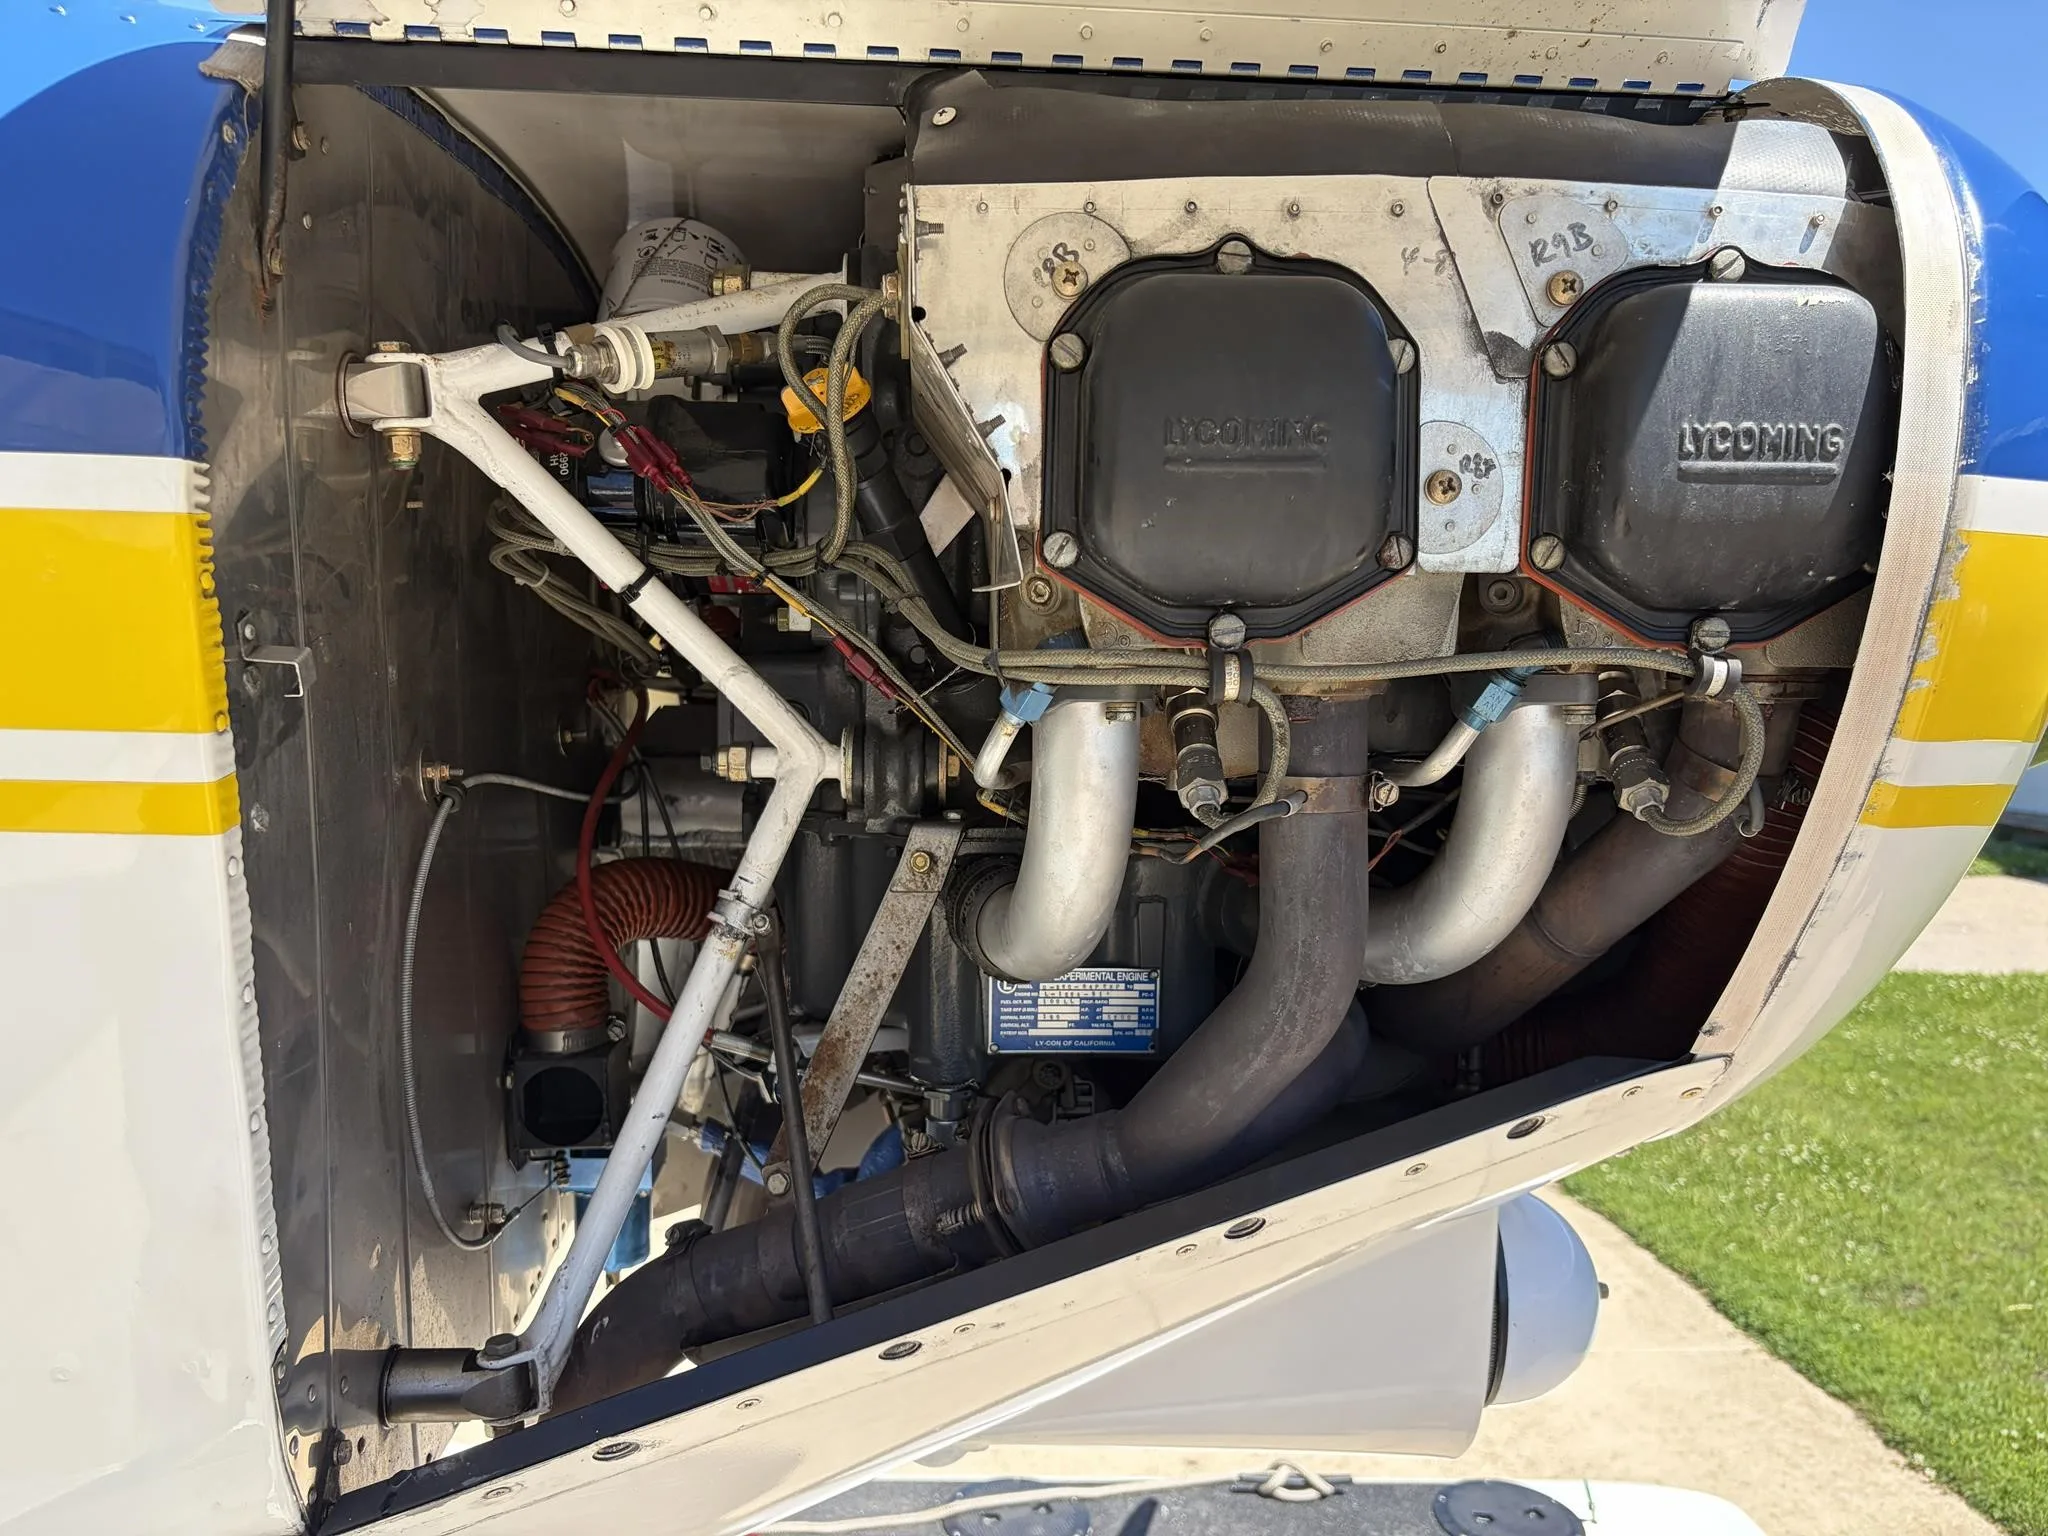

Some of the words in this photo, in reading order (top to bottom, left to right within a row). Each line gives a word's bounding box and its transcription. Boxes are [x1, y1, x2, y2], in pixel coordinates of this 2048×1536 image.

[1164, 414, 1330, 450] LYCOMING
[1678, 420, 1845, 462] LYCOMING
[1054, 971, 1116, 982] PERIMENTAL
[1117, 972, 1149, 982] ENGINE
[1074, 1040, 1116, 1048] CALIFORNIA
